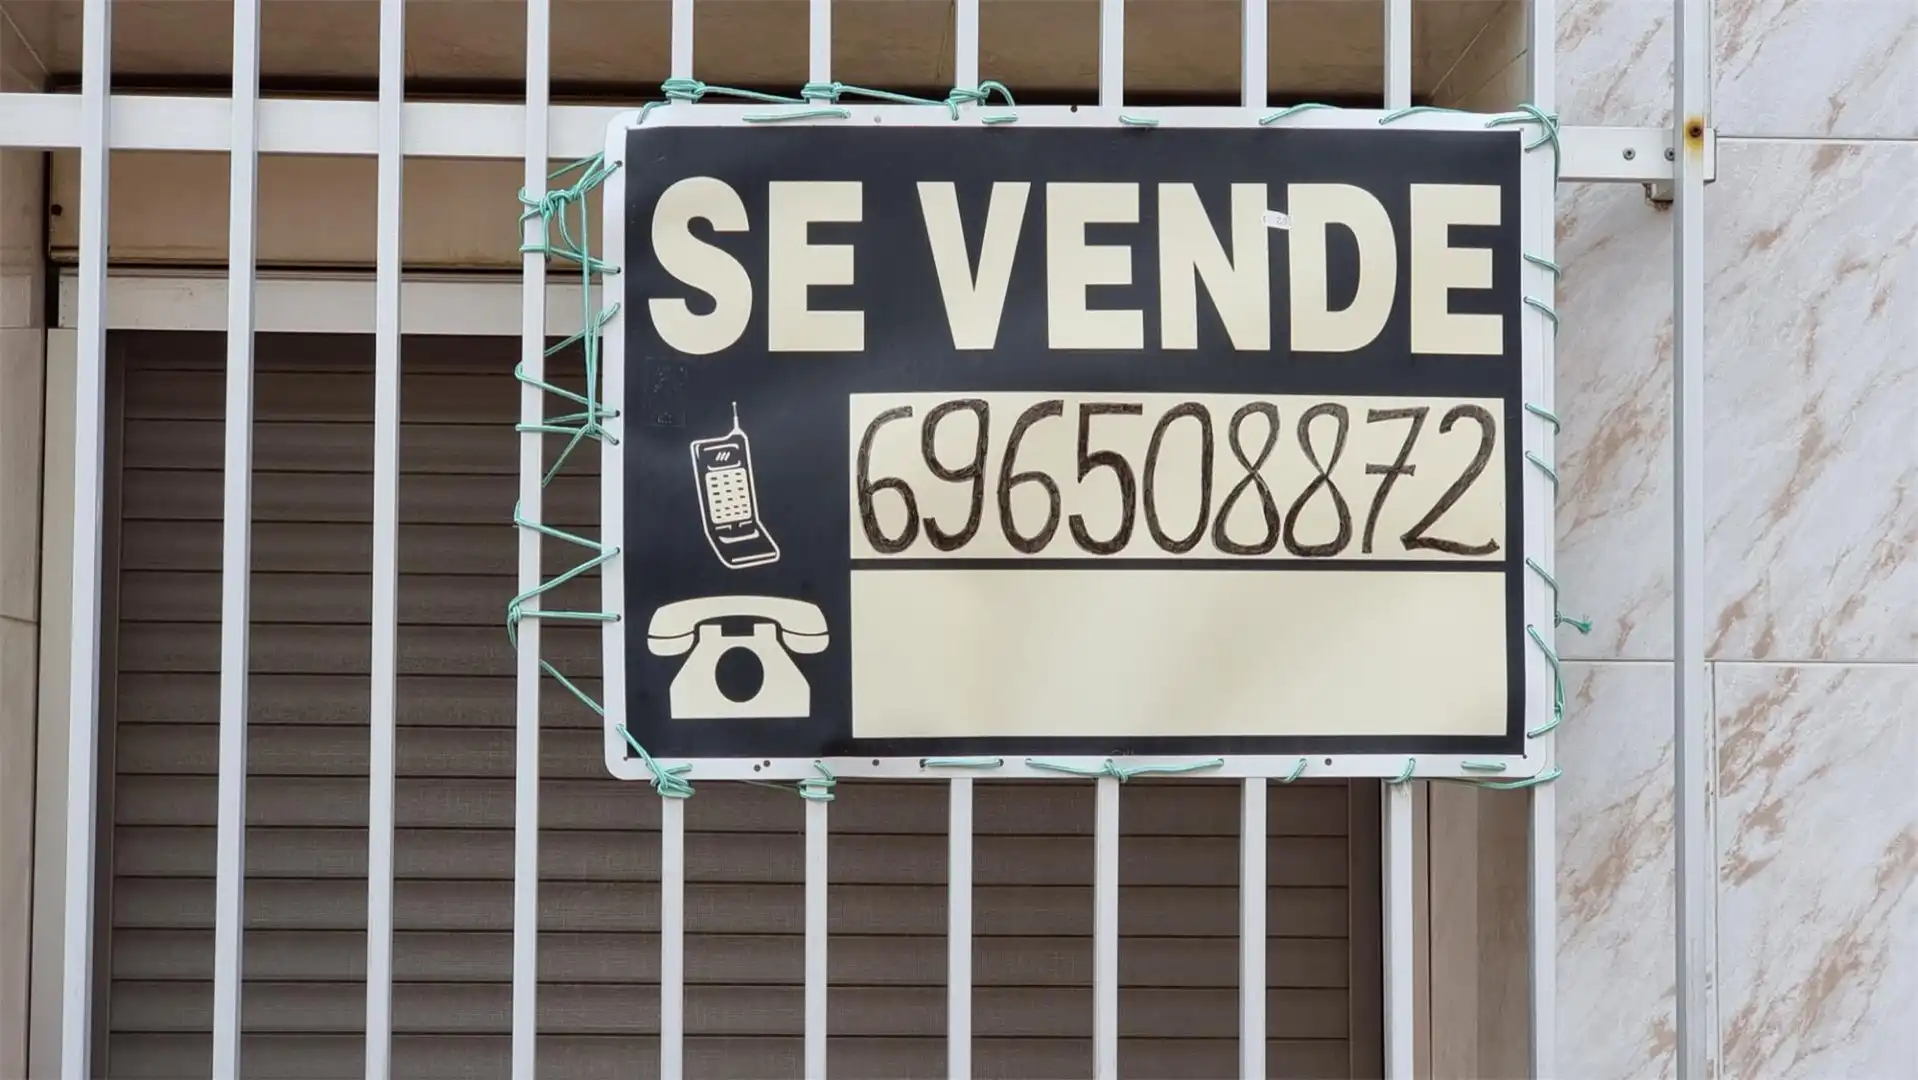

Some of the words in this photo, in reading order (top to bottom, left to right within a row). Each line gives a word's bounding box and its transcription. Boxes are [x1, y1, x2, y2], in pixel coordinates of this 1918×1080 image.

[648, 177, 865, 354] SE
[917, 182, 1504, 356] VENDE
[857, 399, 1500, 557] 696508872
